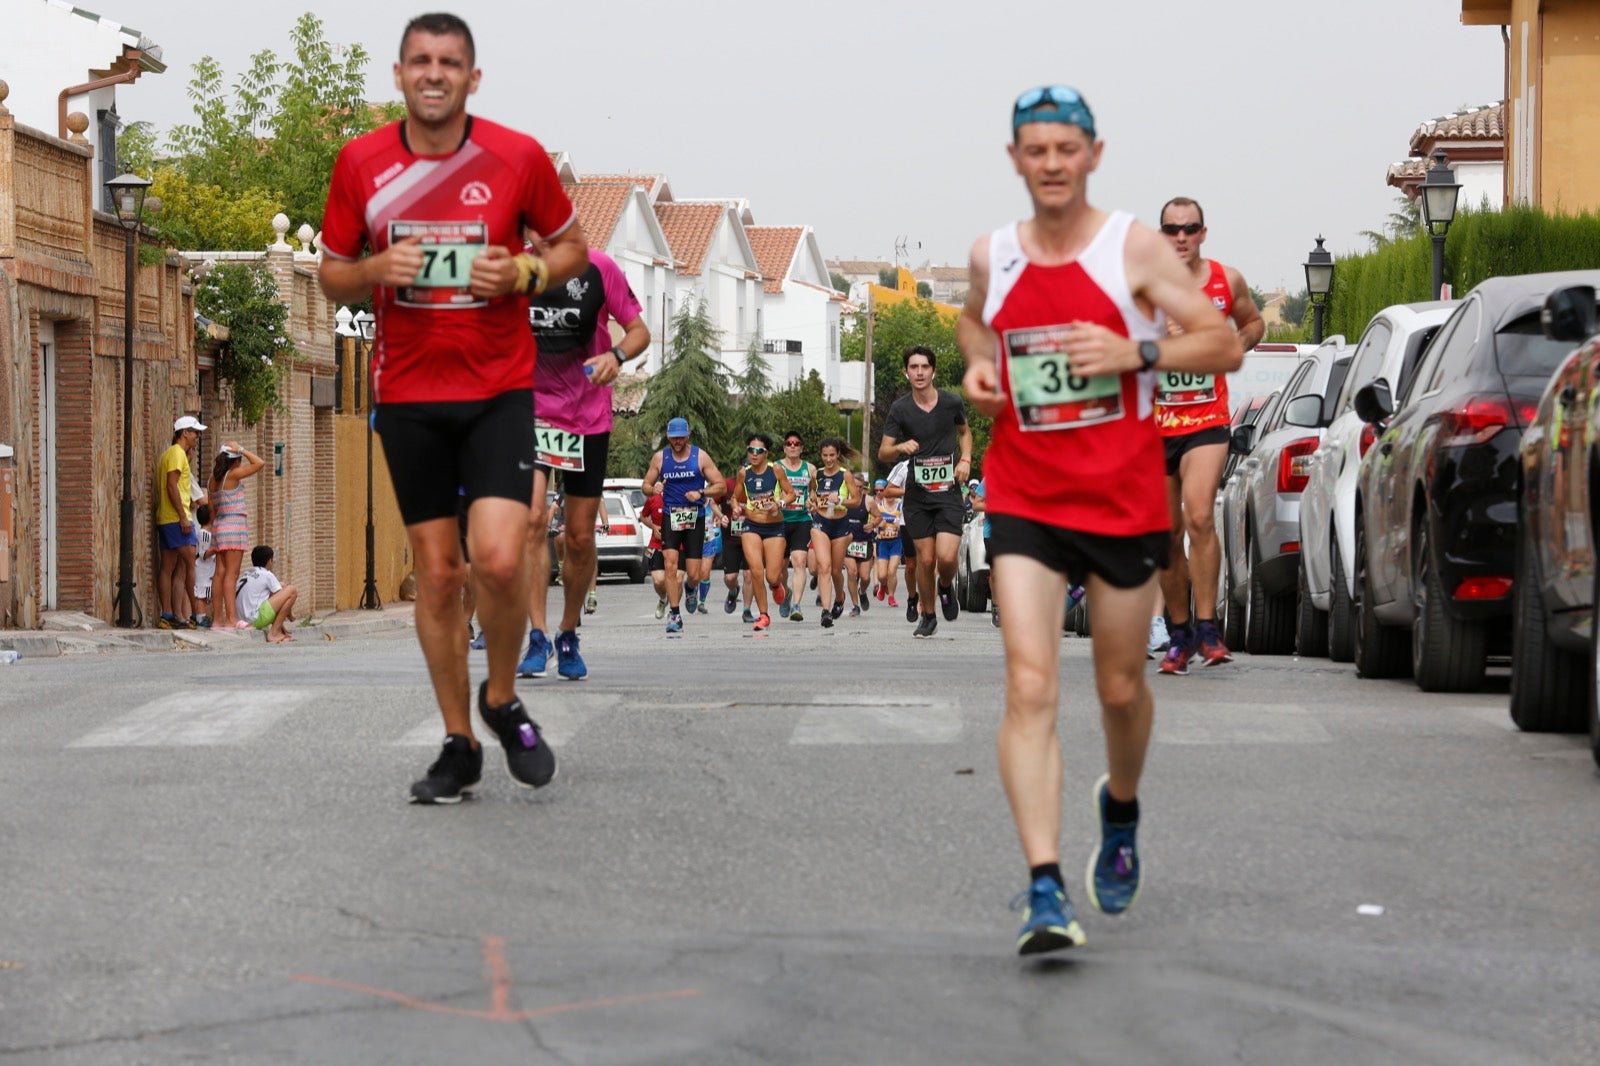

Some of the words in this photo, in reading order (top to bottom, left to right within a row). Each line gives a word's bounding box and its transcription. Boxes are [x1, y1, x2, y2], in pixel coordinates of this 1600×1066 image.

[423, 250, 457, 278] 71
[1167, 371, 1206, 388] 609
[534, 432, 580, 452] 112
[663, 471, 696, 479] GUADIX
[921, 467, 947, 481] 870
[675, 512, 693, 522] 254
[235, 577, 248, 599] 7
